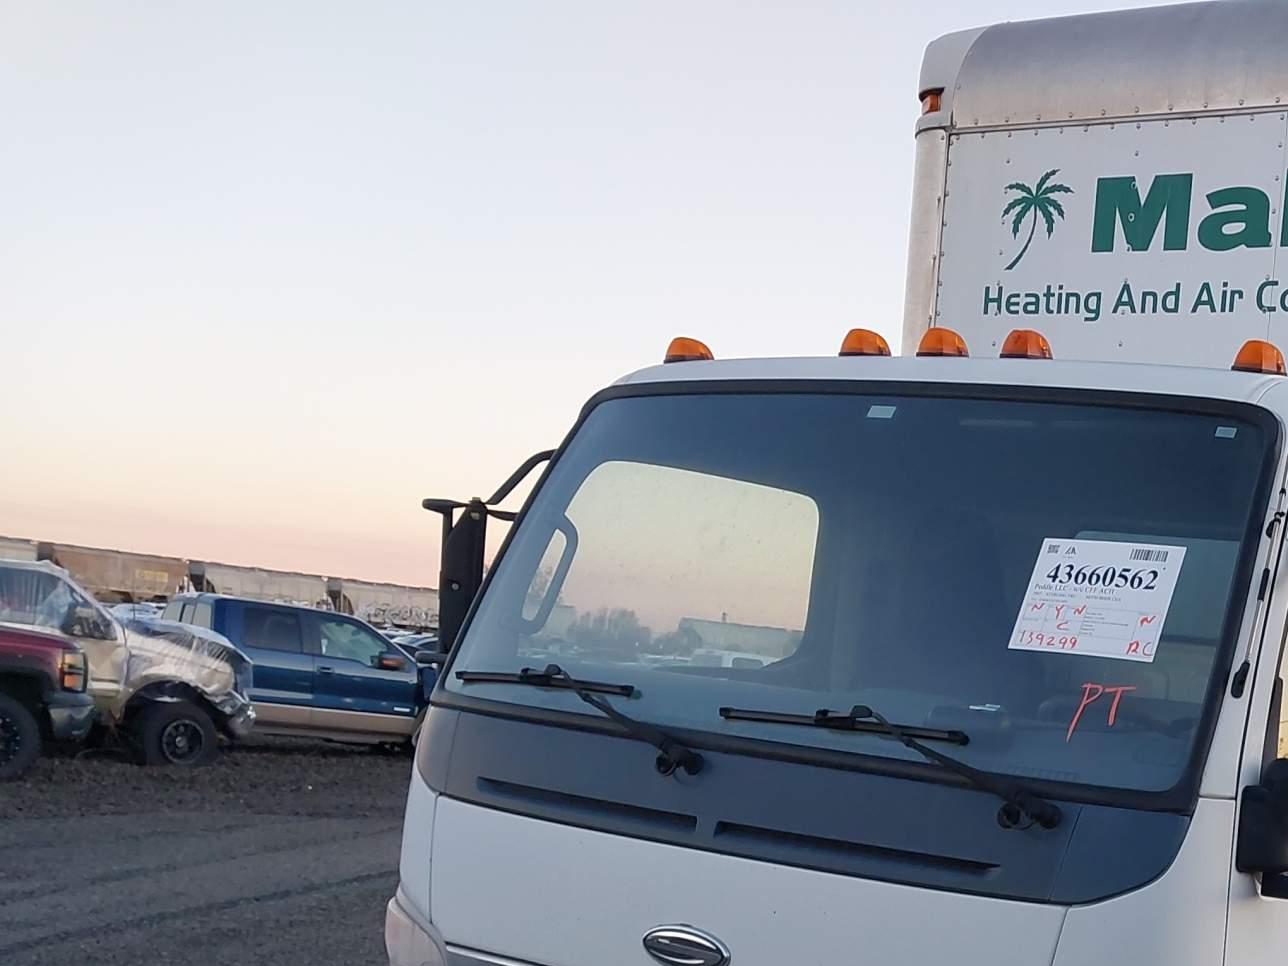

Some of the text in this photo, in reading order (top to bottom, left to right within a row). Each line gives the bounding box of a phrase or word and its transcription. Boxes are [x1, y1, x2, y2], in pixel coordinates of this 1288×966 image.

[983, 286, 1101, 322] Heating
[1114, 281, 1180, 314] And
[1192, 280, 1245, 313] Air
[1046, 562, 1159, 590] 43660562
[1065, 682, 1137, 743] PT
